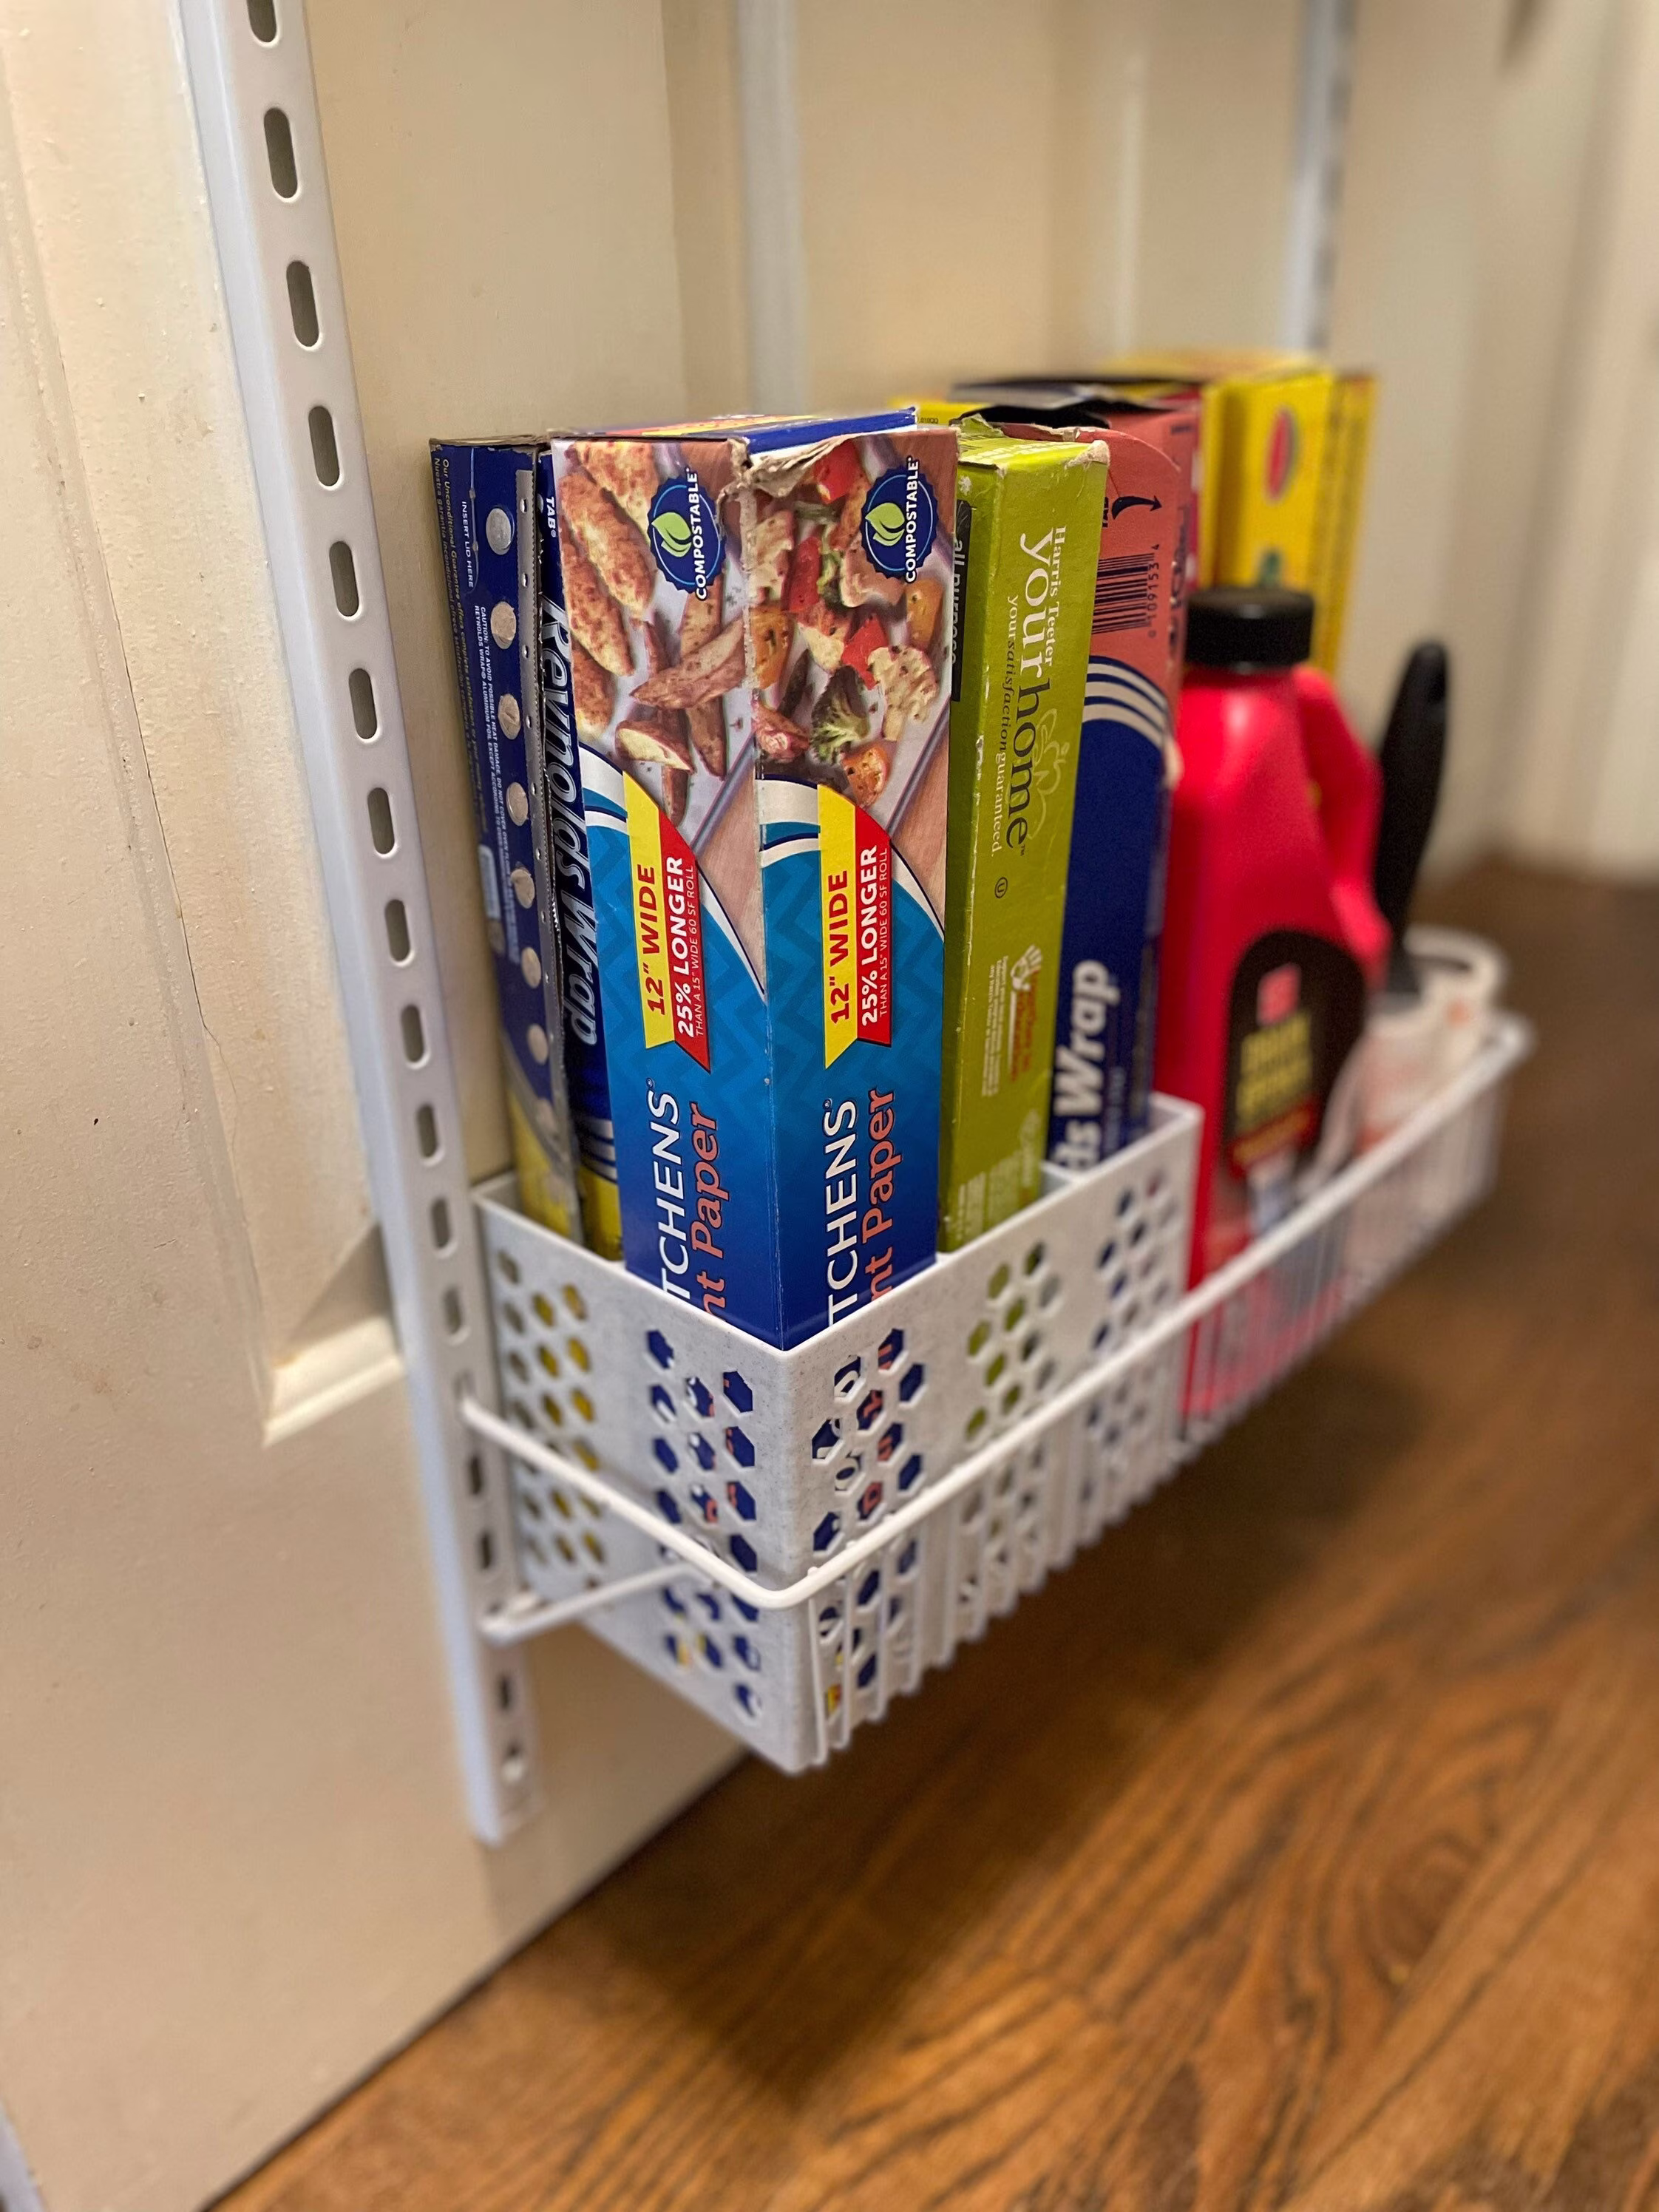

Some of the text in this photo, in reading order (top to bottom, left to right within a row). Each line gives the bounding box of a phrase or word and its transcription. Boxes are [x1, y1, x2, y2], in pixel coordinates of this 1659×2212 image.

[461, 501, 469, 538] INSERT
[444, 481, 456, 548] Unconditional
[451, 550, 460, 600] Guarantee
[1045, 526, 1066, 667] Harris Teeter
[481, 606, 489, 642] CAUTION:
[475, 605, 483, 647] REYNOLDS
[482, 681, 490, 722] ALUMINUM
[484, 645, 490, 656] TO
[487, 682, 496, 722] POSSIBLE
[497, 777, 502, 788] DO
[499, 805, 507, 830] COVER
[685, 865, 695, 902] ROLL
[880, 884, 888, 897] SF
[637, 864, 660, 954] WIDE
[688, 904, 696, 915] SF
[828, 870, 849, 967] WIDE
[880, 900, 887, 915] 60
[689, 920, 698, 934] 60
[861, 845, 878, 1026] 25% LONGER
[666, 856, 695, 1038] 25% LONGER
[689, 939, 699, 971] WIDE
[560, 889, 599, 1046] Wrap
[880, 971, 887, 981] A
[693, 994, 701, 1003] A
[880, 982, 888, 1017] THAN
[694, 1003, 704, 1036] THAN
[1053, 960, 1121, 1117] Wrap
[691, 1101, 730, 1258] Paper
[862, 1088, 903, 1244] Paper
